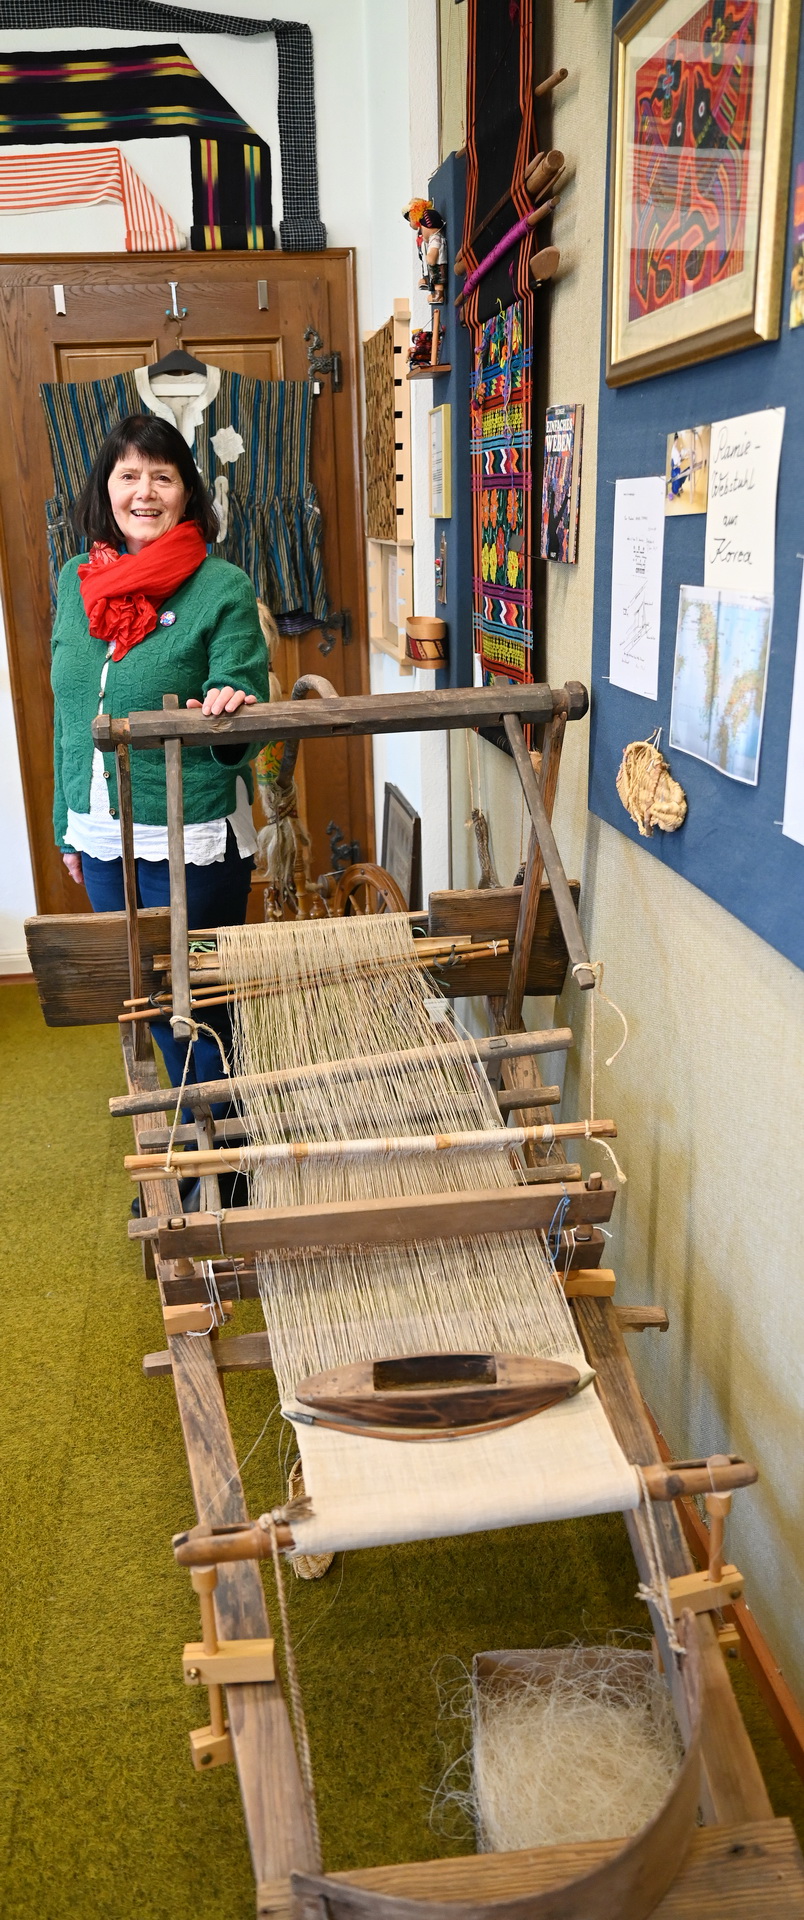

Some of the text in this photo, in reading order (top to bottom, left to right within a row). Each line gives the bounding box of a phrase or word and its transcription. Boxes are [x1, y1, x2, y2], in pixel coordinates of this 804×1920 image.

[546, 418, 573, 433] EINFACHES
[546, 433, 572, 452] WEBEN
[711, 466, 755, 499] Webstuhl
[710, 538, 752, 565] Korea
